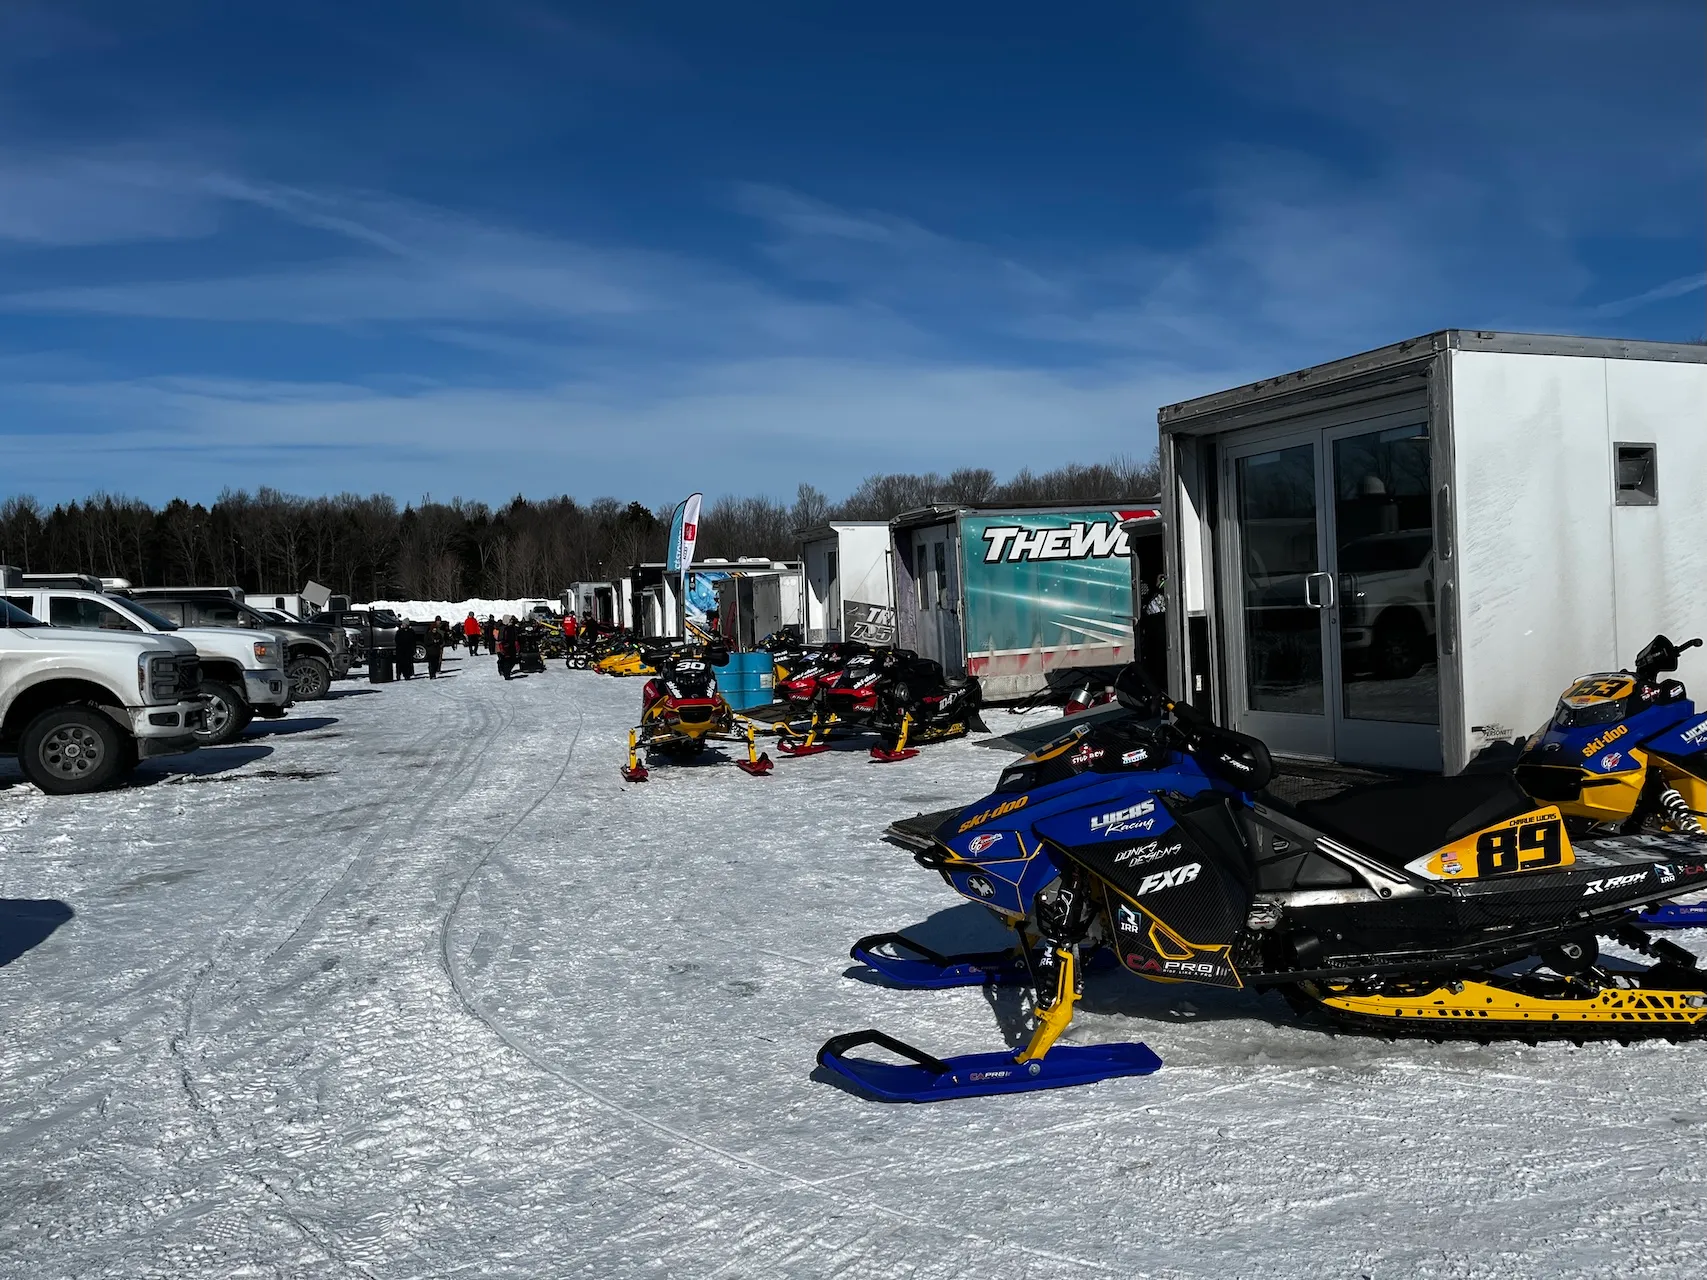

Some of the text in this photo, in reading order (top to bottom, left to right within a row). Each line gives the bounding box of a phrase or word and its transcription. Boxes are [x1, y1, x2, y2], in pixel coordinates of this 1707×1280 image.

[675, 661, 706, 671] 30
[1582, 724, 1629, 757] ski-doo
[1072, 756, 1088, 765] STUD
[958, 795, 1029, 833] ski-doo
[1091, 798, 1155, 832] LUCAS
[1509, 813, 1557, 827] CHARLIE LUCAS
[1104, 818, 1155, 837] Racing
[1476, 819, 1562, 877] 89
[1137, 862, 1202, 897] FXR
[1605, 871, 1649, 889] ROX
[1660, 876, 1676, 884] IRR
[1121, 922, 1138, 933] IRR
